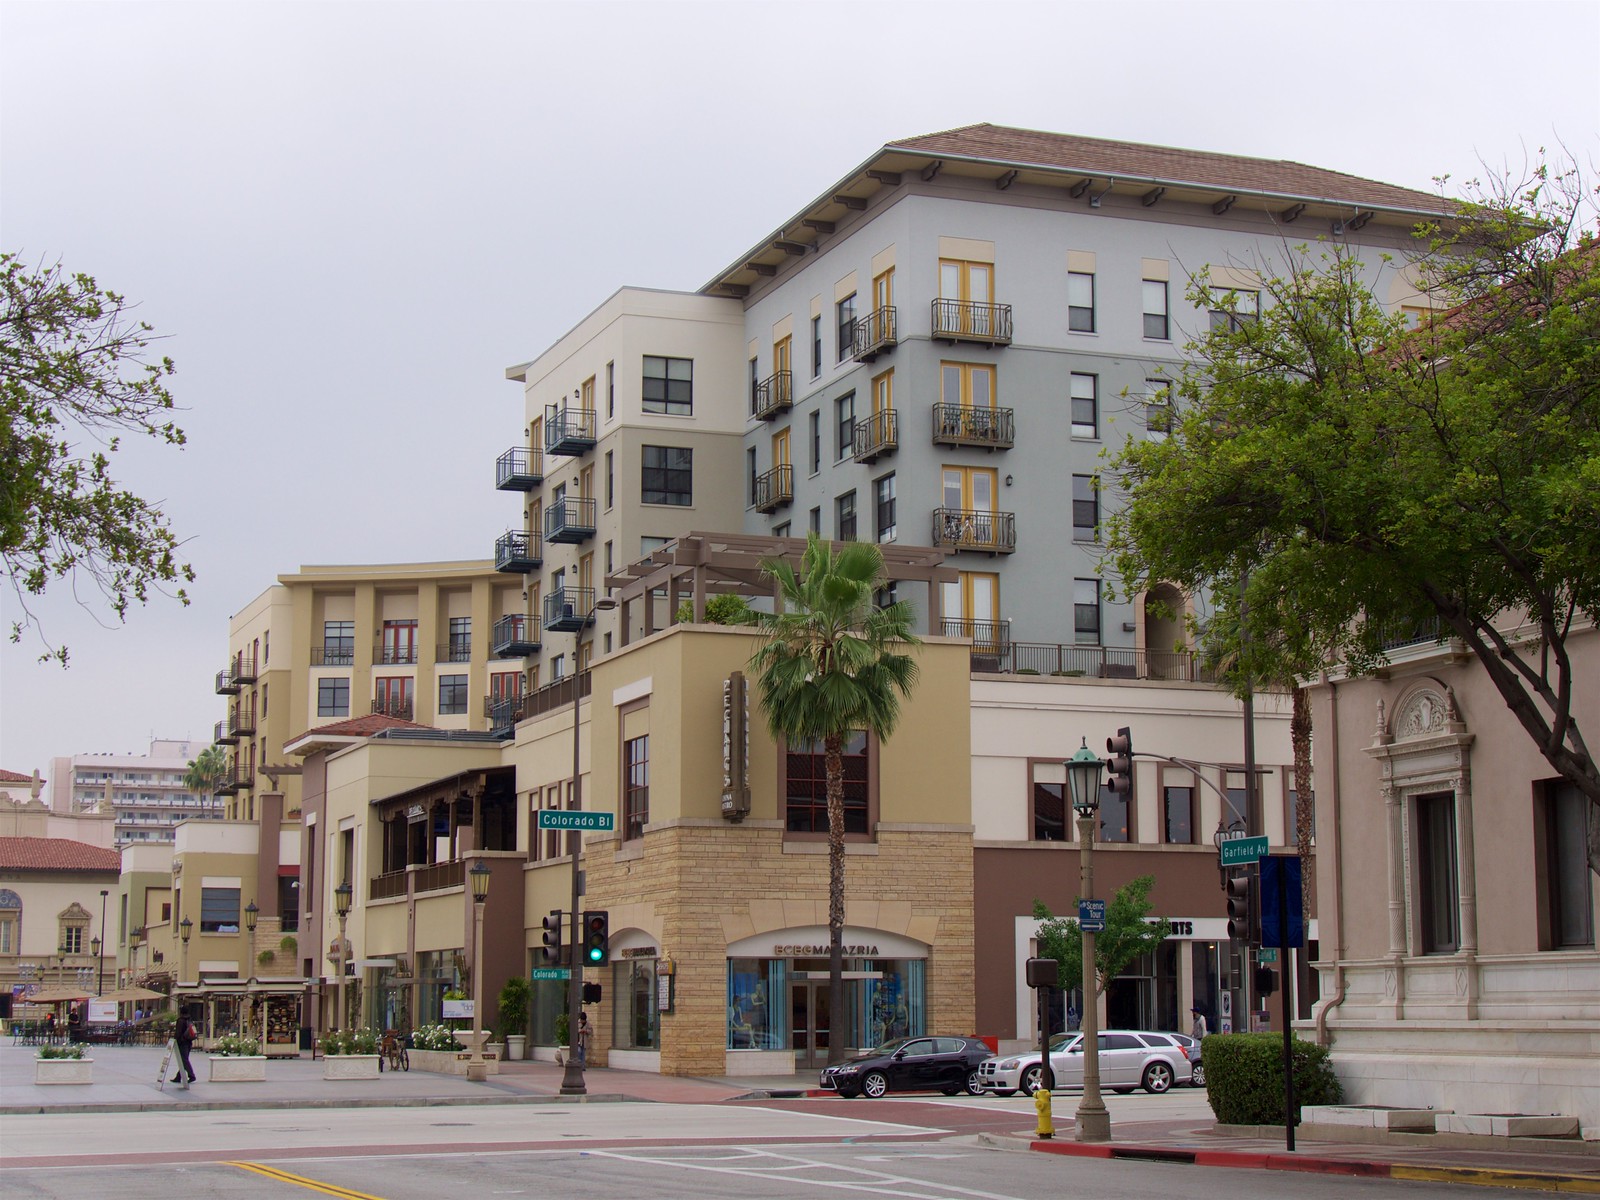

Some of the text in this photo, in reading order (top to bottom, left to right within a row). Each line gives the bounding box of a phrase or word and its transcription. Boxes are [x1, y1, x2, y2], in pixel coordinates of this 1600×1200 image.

[543, 814, 610, 827] Colorado Bl
[1224, 844, 1266, 858] Garfield Av
[1086, 901, 1104, 910] Scenic
[1089, 909, 1102, 918] Tour
[1149, 921, 1193, 935] RTS
[774, 944, 880, 956] BCBGMAAZRIA
[533, 969, 558, 979] Colorado
